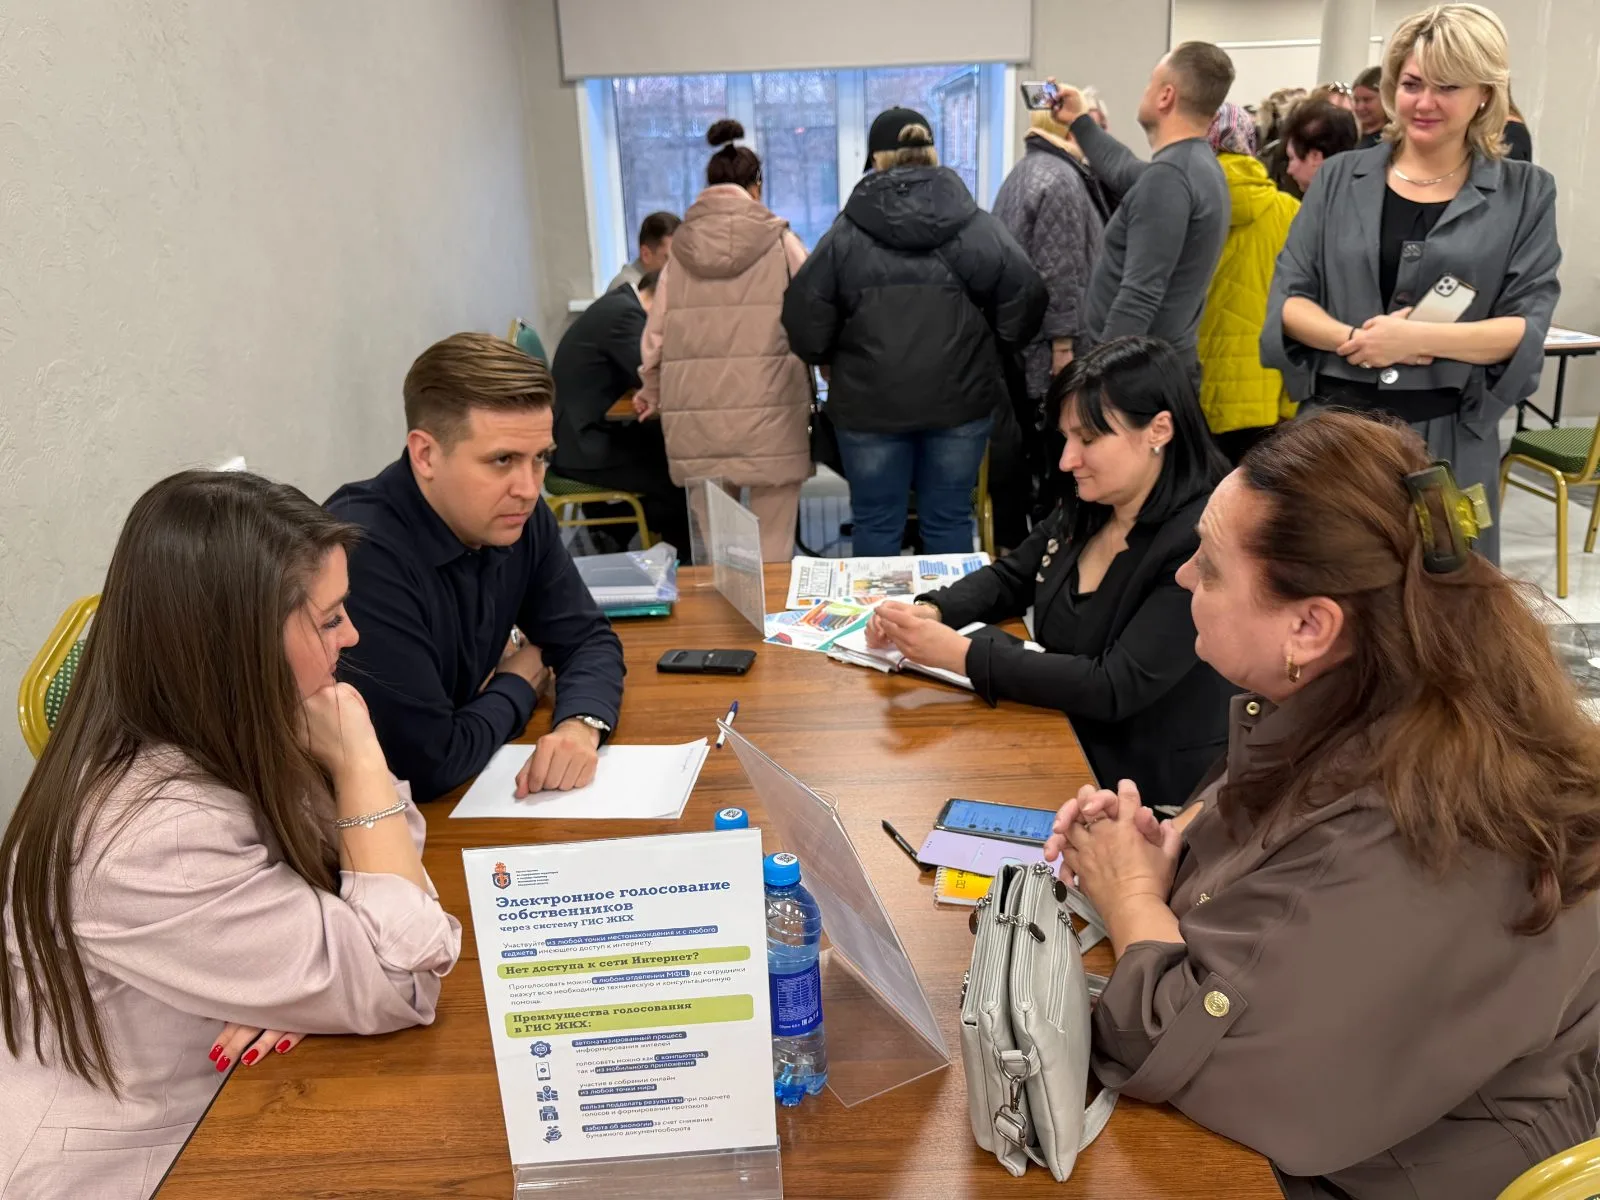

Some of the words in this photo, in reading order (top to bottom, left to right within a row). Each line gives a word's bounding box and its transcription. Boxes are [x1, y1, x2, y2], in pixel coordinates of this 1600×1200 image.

[495, 890, 614, 907] Электронное
[619, 881, 730, 897] голосование
[497, 902, 633, 921] собственников
[499, 924, 530, 933] через
[532, 921, 578, 929] систему
[580, 917, 603, 925] ГИС
[605, 914, 634, 923] ЖКХ
[502, 940, 545, 948] Участвуйте
[556, 936, 582, 945] любой
[607, 930, 675, 941] местонахождения
[538, 946, 578, 954] имеющего
[505, 966, 528, 974] Нет
[531, 962, 584, 973] доступа
[598, 958, 628, 967] сети
[631, 951, 699, 964] Интернет?
[508, 981, 565, 990] Проголосовать
[625, 973, 665, 981] отделении
[703, 967, 745, 975] сотрудники
[553, 986, 605, 994] необходимую
[606, 982, 654, 990] техническую
[662, 976, 731, 985] консультационную
[512, 1009, 610, 1024] Преимущества
[612, 1002, 691, 1014] голосования
[524, 1022, 551, 1032] ГИС
[554, 1019, 591, 1030] ЖКХ:
[573, 1034, 651, 1045] автоматизированный
[652, 1032, 682, 1040] процесс
[575, 1044, 638, 1053] информирования
[605, 1062, 649, 1071] мобильного
[650, 1060, 695, 1068] приложения
[636, 1084, 655, 1092] мира
